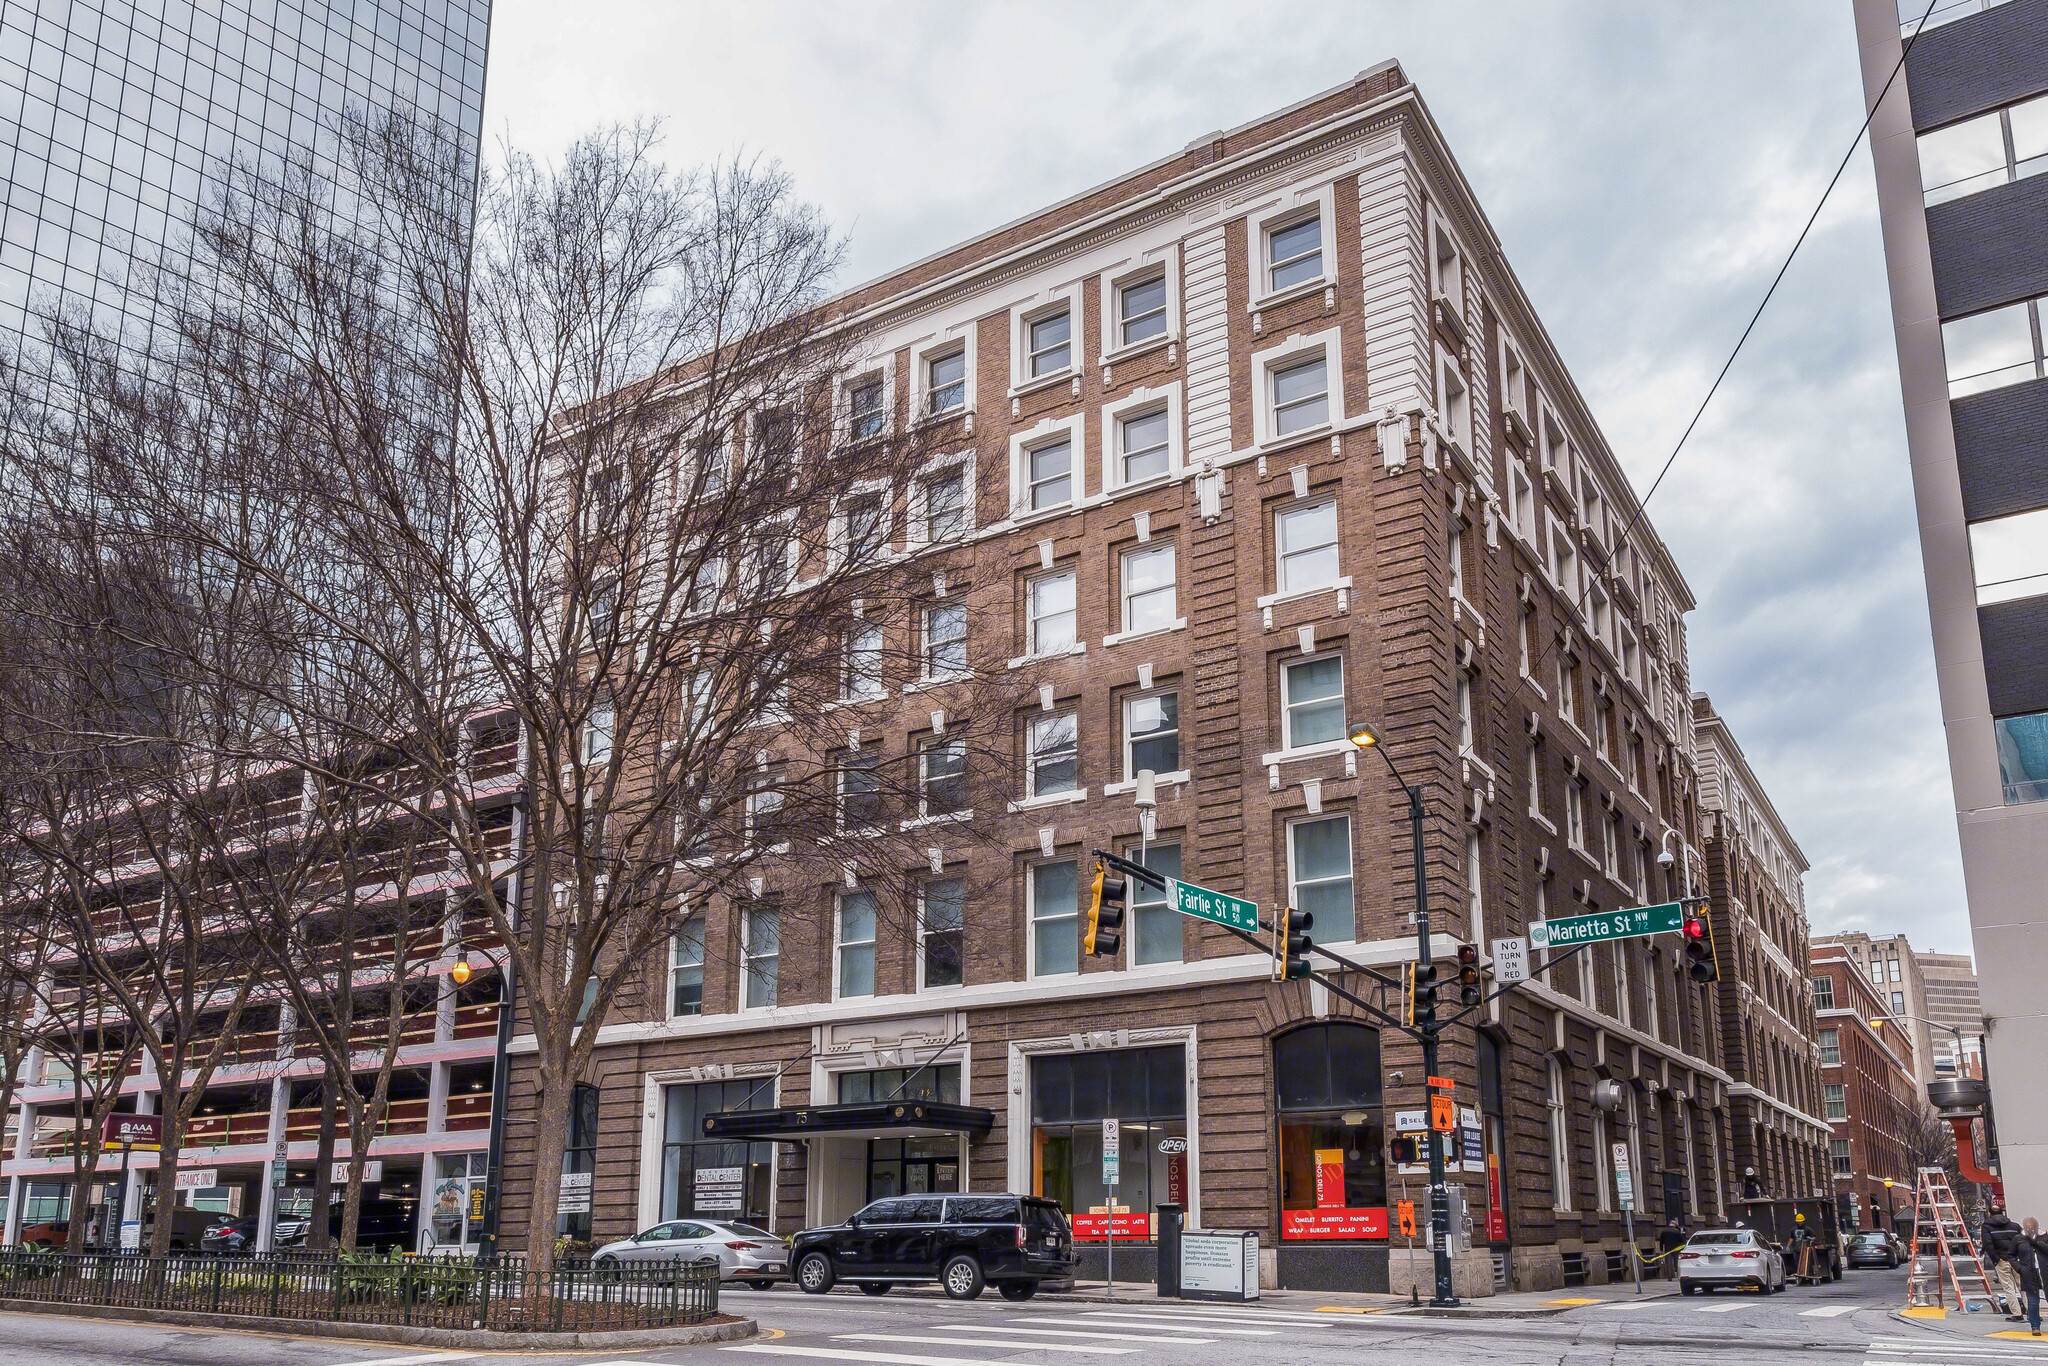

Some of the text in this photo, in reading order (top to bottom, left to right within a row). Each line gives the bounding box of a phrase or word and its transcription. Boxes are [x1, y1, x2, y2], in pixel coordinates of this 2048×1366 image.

[1178, 887, 1240, 919] Fairlie St NW
[1232, 912, 1240, 924] 50
[1550, 912, 1648, 942] Marietta St NW
[1636, 922, 1648, 930] 72
[1502, 942, 1518, 950] NO
[1500, 952, 1520, 960] TURN
[1432, 1098, 1452, 1109] DETOUR
[796, 1114, 807, 1124] 75
[1161, 1140, 1186, 1152] OPEN
[337, 1164, 348, 1180] EXI
[176, 1173, 214, 1187] NTRANCE ONLY
